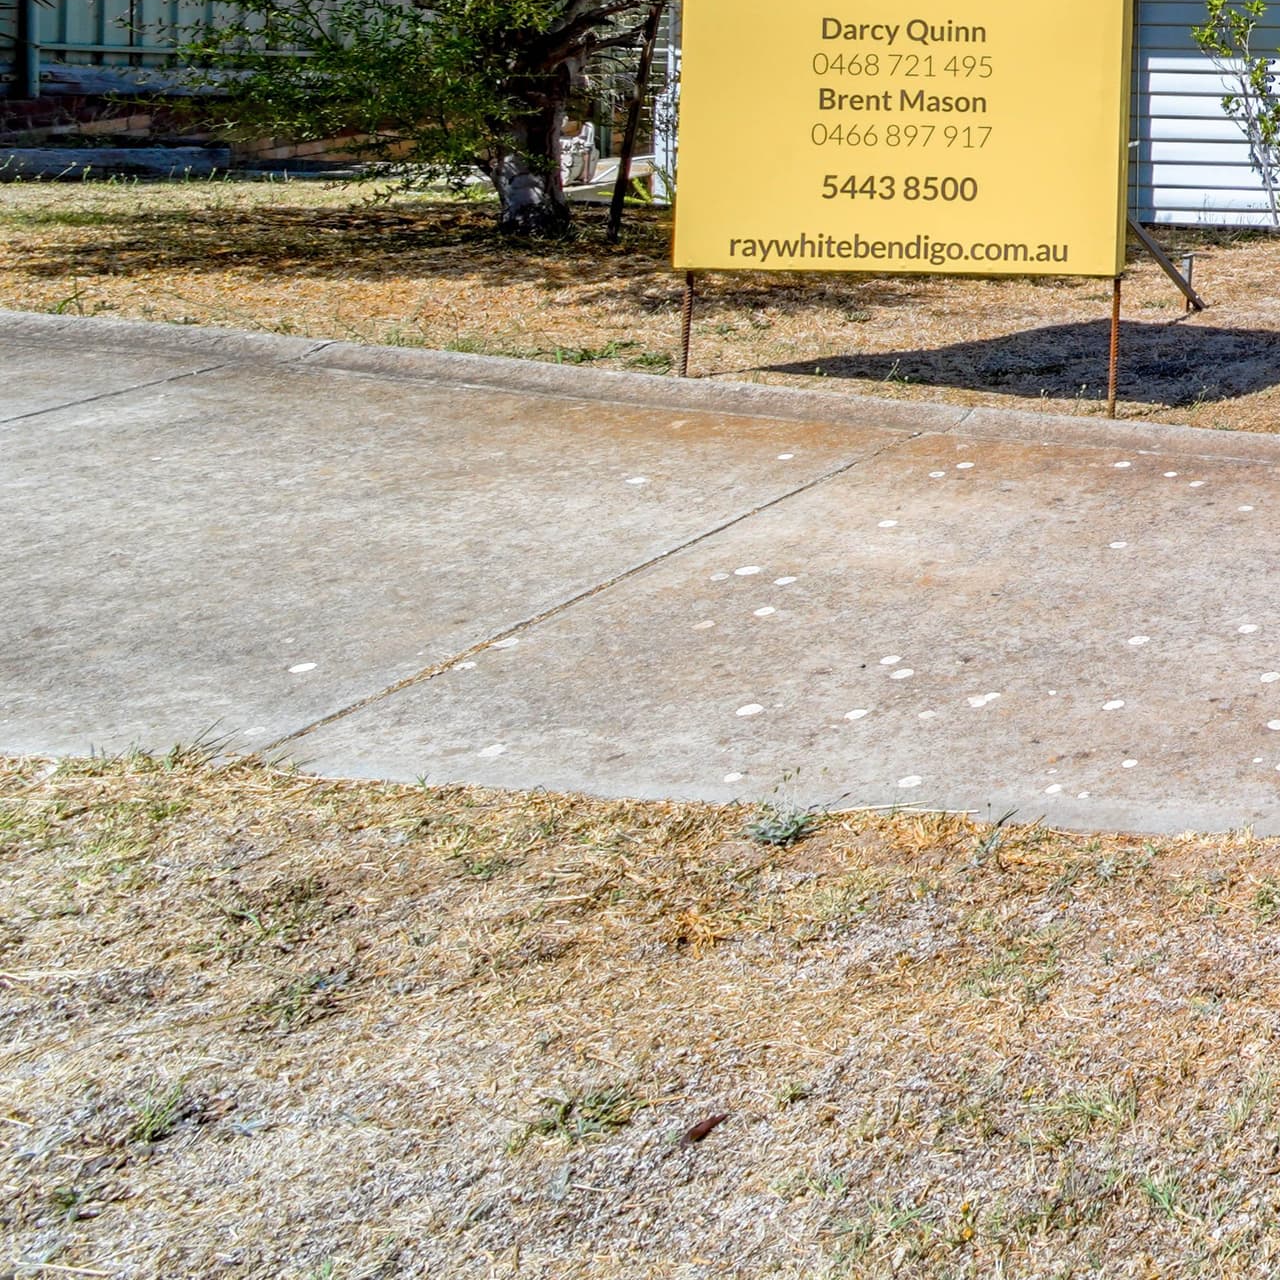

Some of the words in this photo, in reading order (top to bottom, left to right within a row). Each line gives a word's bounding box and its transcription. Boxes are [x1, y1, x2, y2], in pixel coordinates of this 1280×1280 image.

[822, 17, 900, 45] Darcy
[906, 18, 987, 44] Quinn
[812, 53, 880, 76] 0468
[887, 54, 936, 77] 721
[944, 55, 993, 78] 495
[818, 88, 892, 111] Brent
[900, 89, 987, 113] Mason
[811, 123, 879, 147] 0466
[886, 124, 936, 148] 897
[944, 125, 993, 149] 917
[821, 174, 896, 201] 5443
[903, 175, 979, 202] 8500
[729, 233, 1068, 264] raywhitebendigo.com.au
